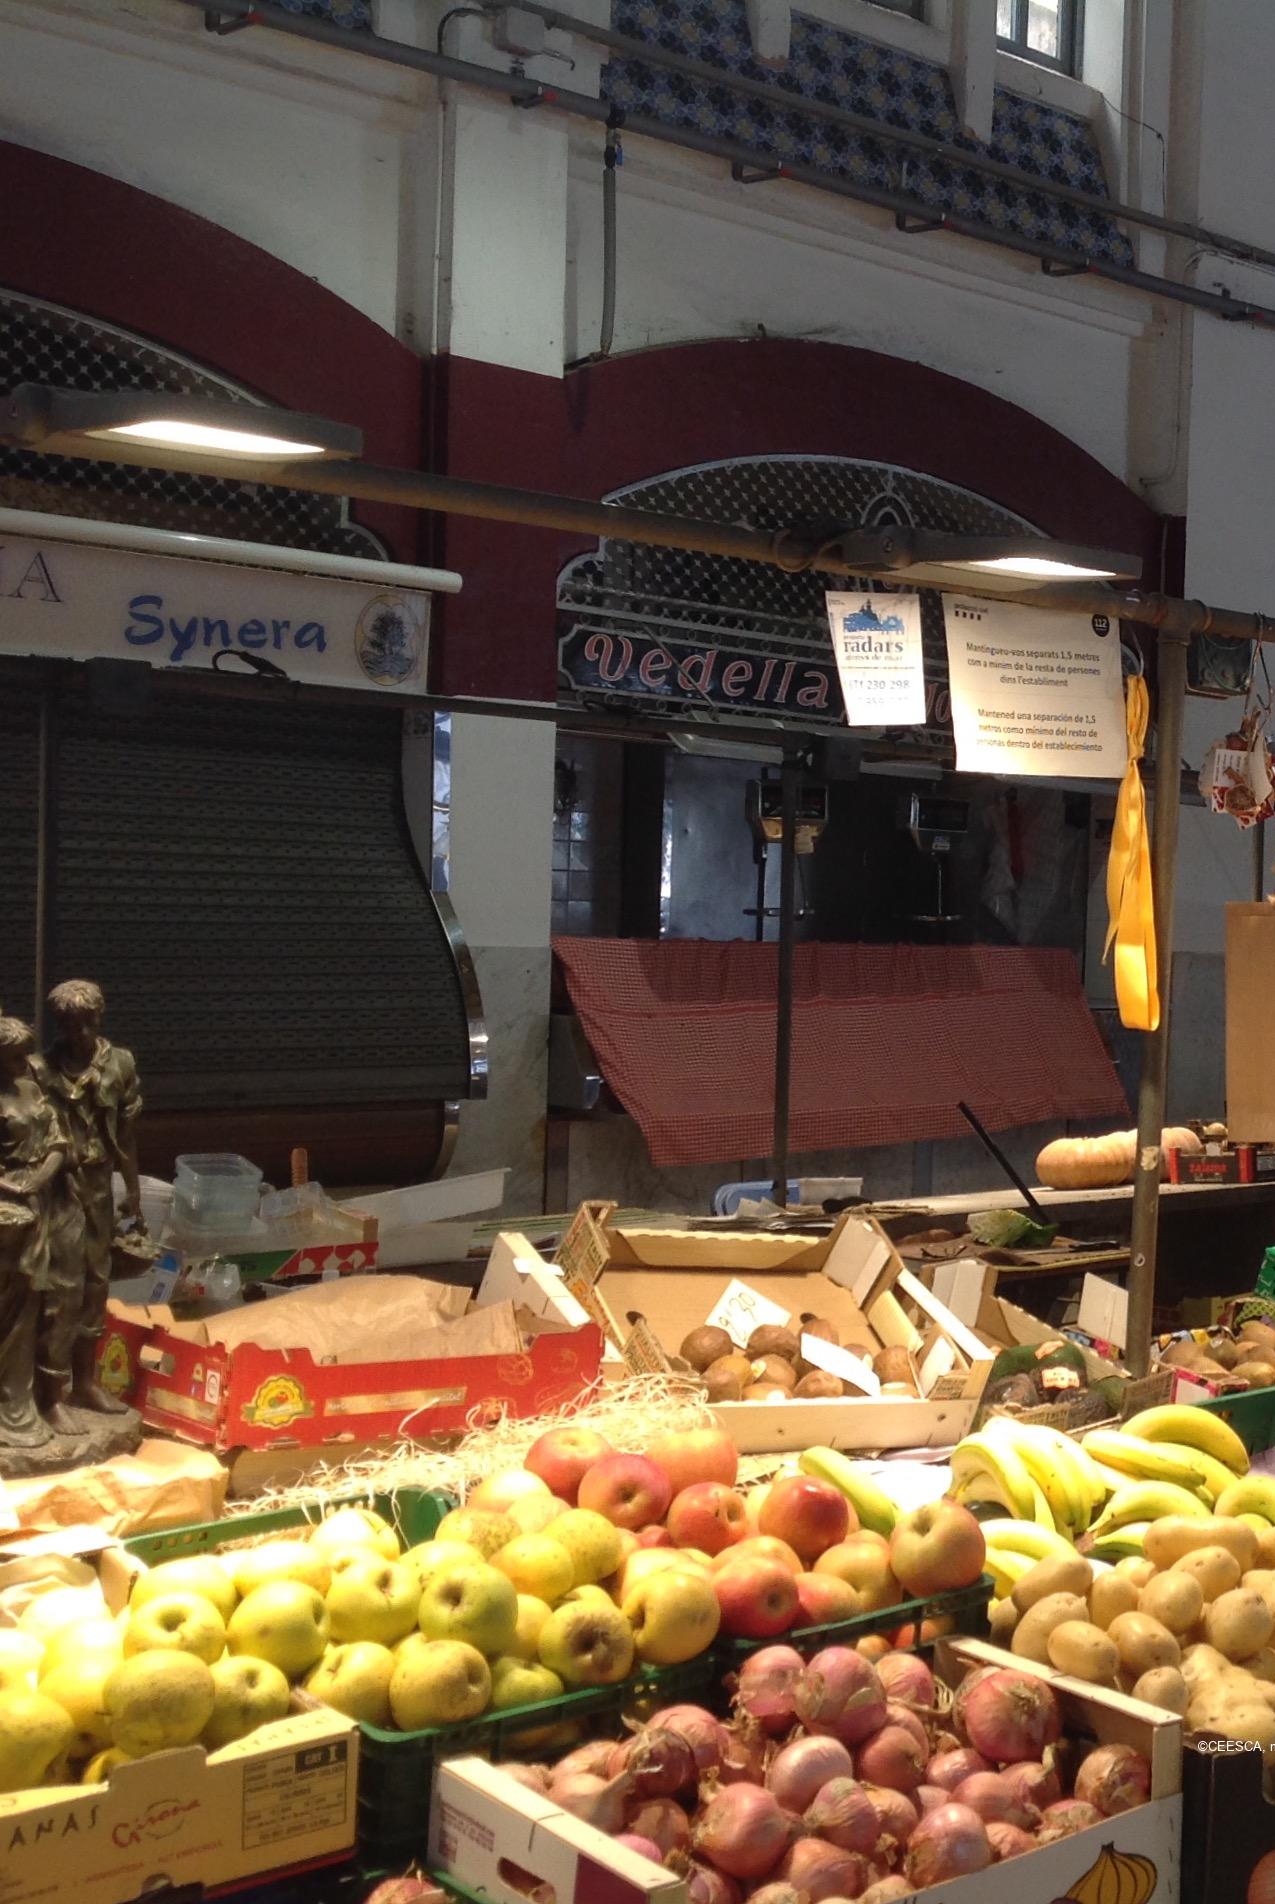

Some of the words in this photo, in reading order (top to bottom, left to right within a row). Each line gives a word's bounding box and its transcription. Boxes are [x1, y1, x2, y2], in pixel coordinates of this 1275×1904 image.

[0, 546, 63, 603] A
[124, 594, 327, 662] Synera
[843, 635, 904, 653] radars
[1026, 650, 1059, 661] separats
[1074, 652, 1101, 662] metres
[584, 633, 829, 709] Vedella
[967, 659, 982, 667] com
[1014, 662, 1024, 671] de
[1026, 662, 1033, 672] la
[1034, 664, 1055, 673] resta
[1056, 664, 1066, 674] de
[1067, 666, 1101, 677] persones
[1000, 675, 1017, 685] dins
[978, 708, 1015, 721] Mantened
[1017, 712, 1031, 721] una
[1033, 711, 1073, 723] separación
[1074, 713, 1084, 723] de
[1003, 727, 1023, 735] como
[1055, 727, 1067, 737] del
[1068, 729, 1087, 738] resto
[1088, 729, 1098, 739] de
[1007, 739, 1031, 749] dentro
[1032, 740, 1044, 750] del
[1045, 741, 1104, 752] establecimiento
